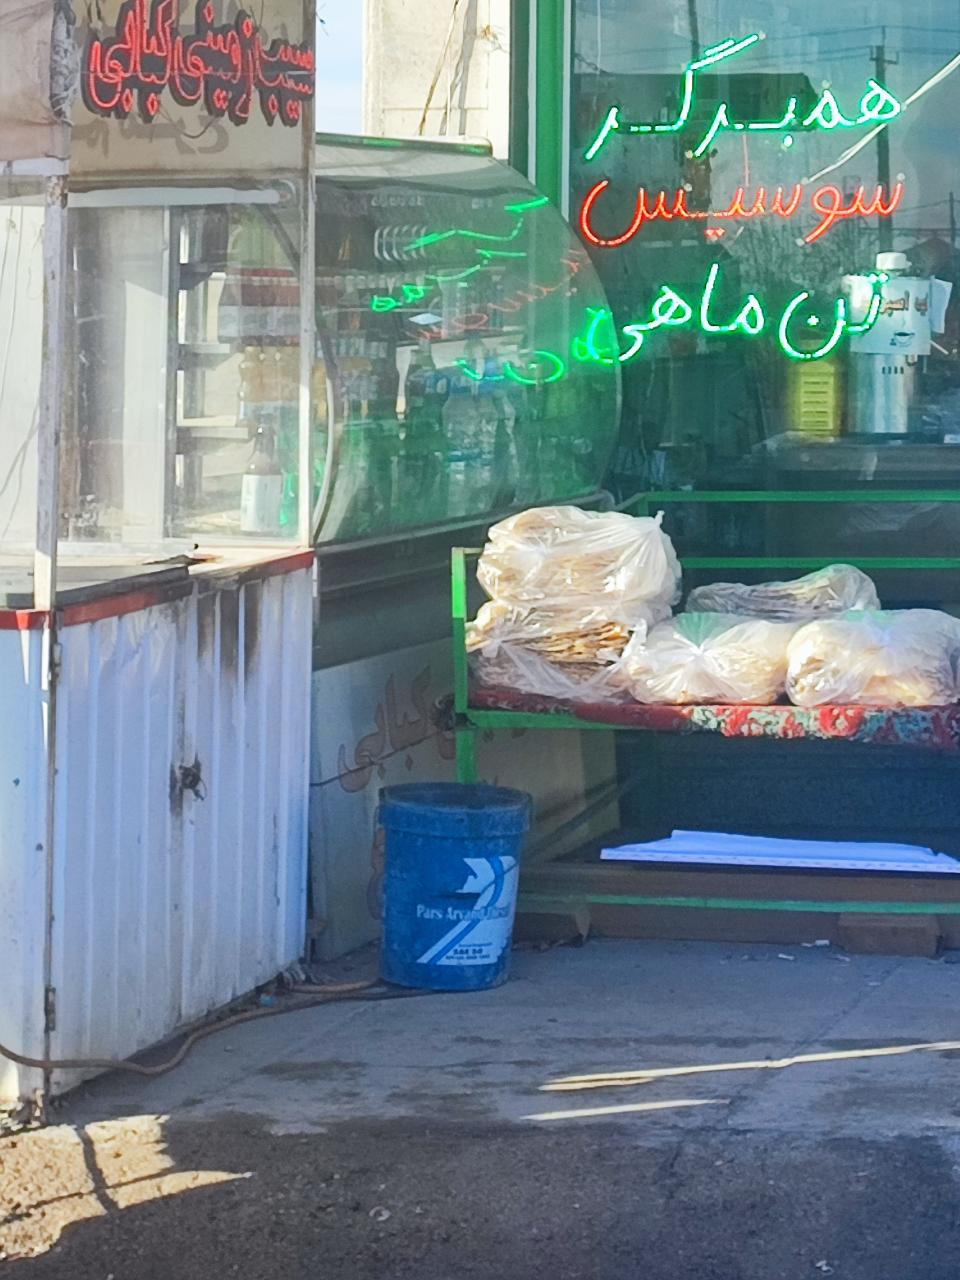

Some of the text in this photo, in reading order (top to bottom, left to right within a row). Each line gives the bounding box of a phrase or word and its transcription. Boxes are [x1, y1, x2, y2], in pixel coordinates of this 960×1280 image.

[584, 31, 903, 161] همبرگر
[581, 177, 907, 247] سوسیس
[587, 262, 889, 364] تن ماهی
